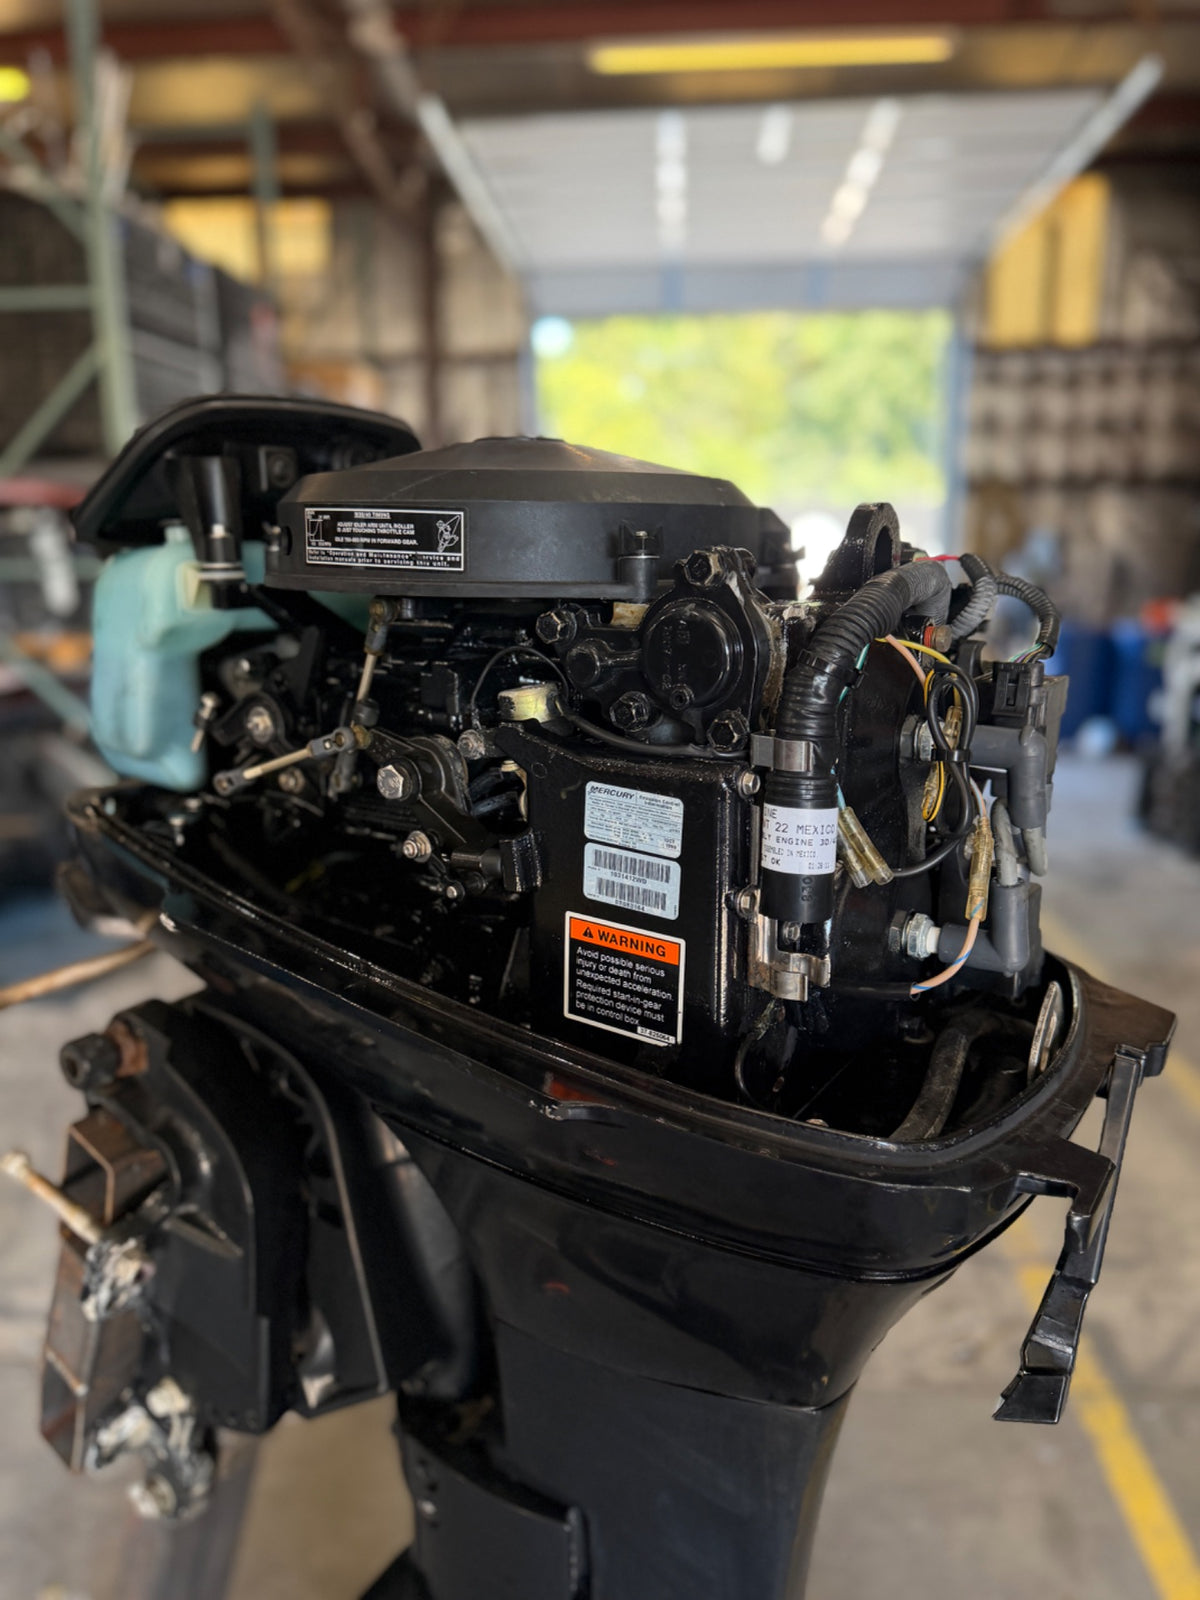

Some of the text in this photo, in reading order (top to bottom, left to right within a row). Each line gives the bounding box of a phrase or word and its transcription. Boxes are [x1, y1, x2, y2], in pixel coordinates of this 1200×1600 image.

[589, 786, 634, 800] MERCURY
[775, 822, 788, 833] 22
[796, 824, 836, 836] MEXICO
[776, 836, 814, 846] ENGINE
[770, 857, 781, 866] OK
[598, 928, 667, 958] WARNING
[576, 946, 666, 978] Avoid possible serious
[576, 958, 652, 985] injury or death from
[576, 968, 674, 1002] unexpected acceleration.
[576, 978, 662, 1010] Required start-in-gear
[576, 990, 664, 1023] protection device must
[576, 1000, 586, 1010] be
[587, 1004, 594, 1012] in
[596, 1006, 623, 1020] control
